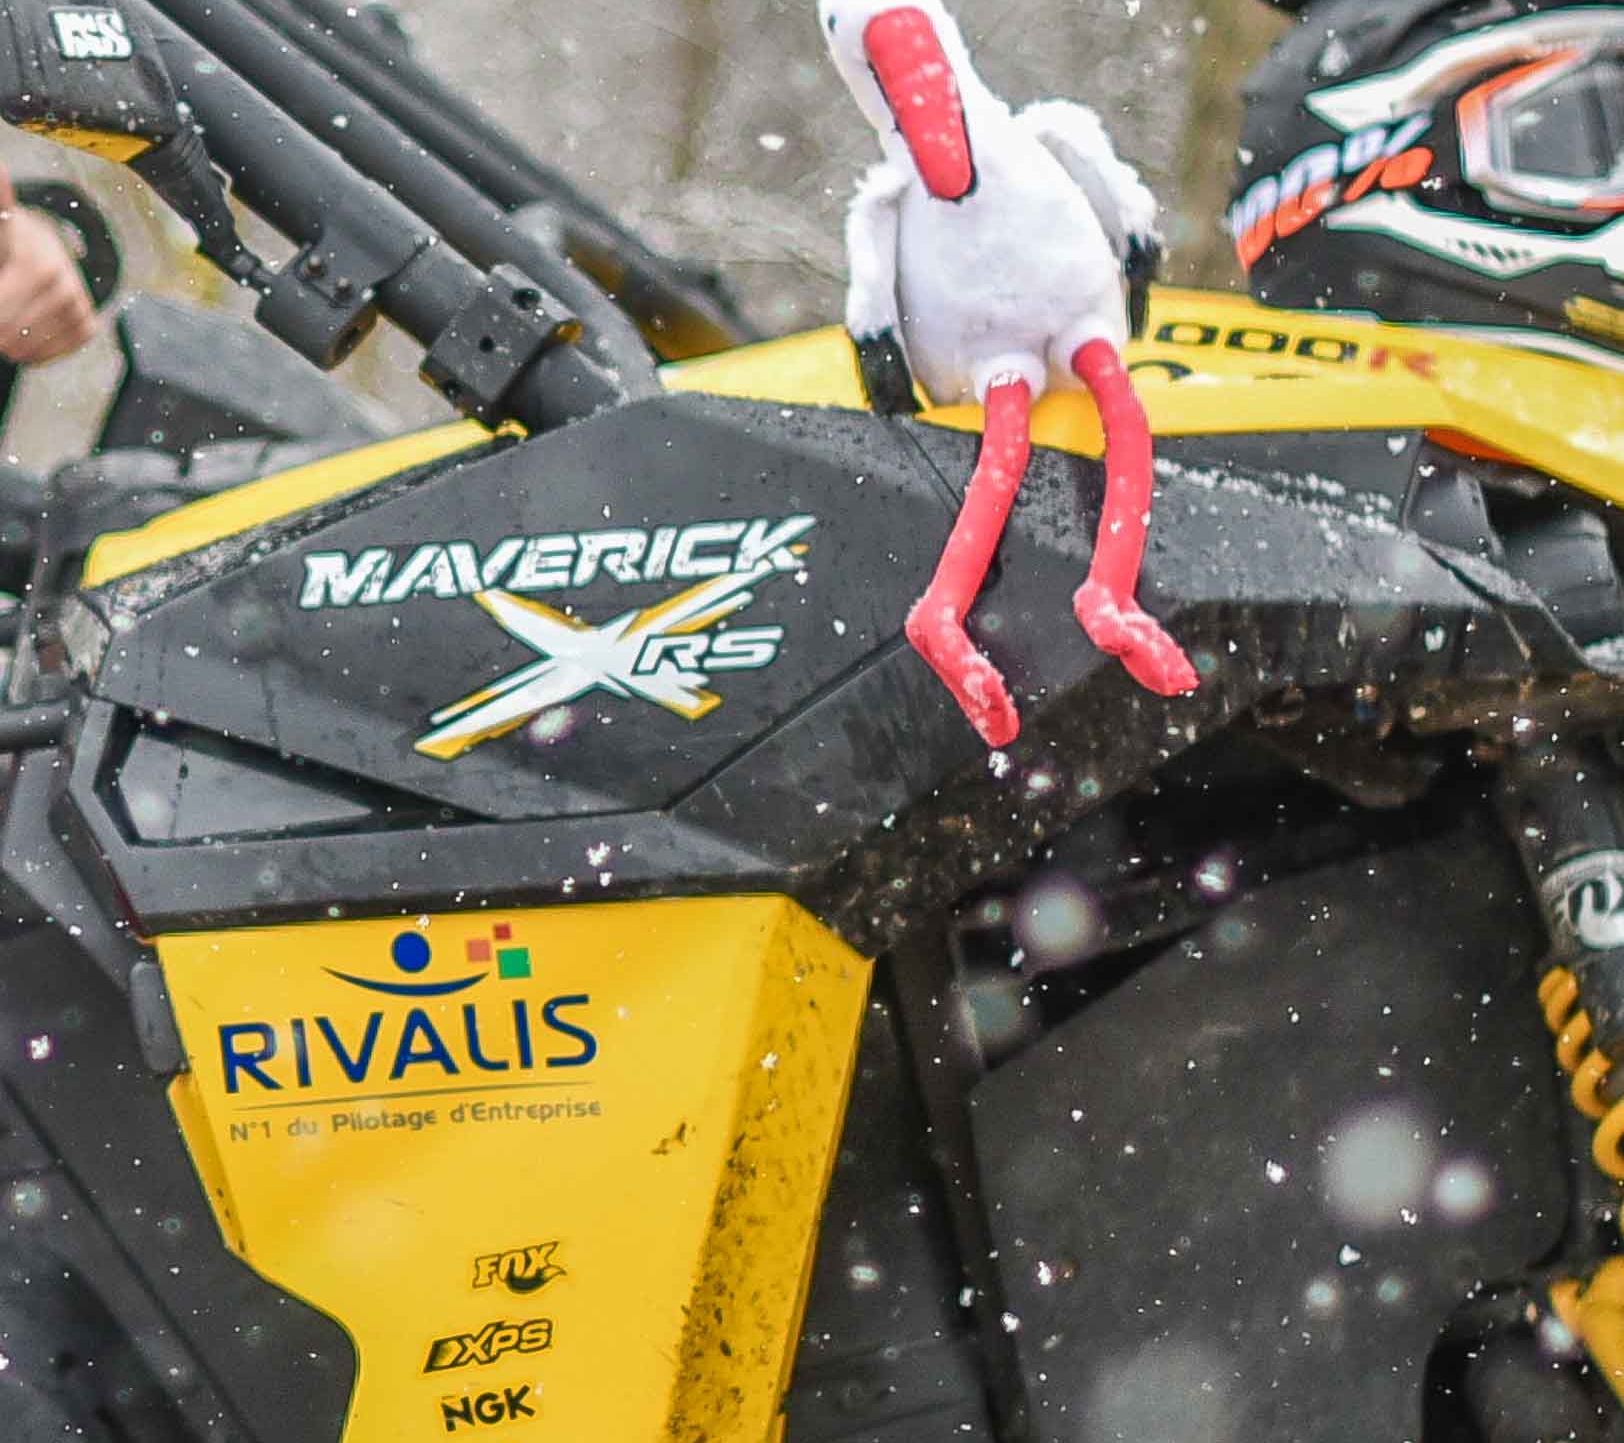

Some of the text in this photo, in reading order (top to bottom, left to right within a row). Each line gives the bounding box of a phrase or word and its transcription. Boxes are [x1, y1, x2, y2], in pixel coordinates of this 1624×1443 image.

[299, 513, 818, 610] MAVERICK
[217, 994, 599, 1095] RIVALIS
[287, 1116, 319, 1138] du
[331, 1108, 439, 1134] Pilotage
[450, 1097, 602, 1125] d'Entreprise
[472, 1240, 566, 1294] FOX
[441, 1385, 536, 1432] NGK
